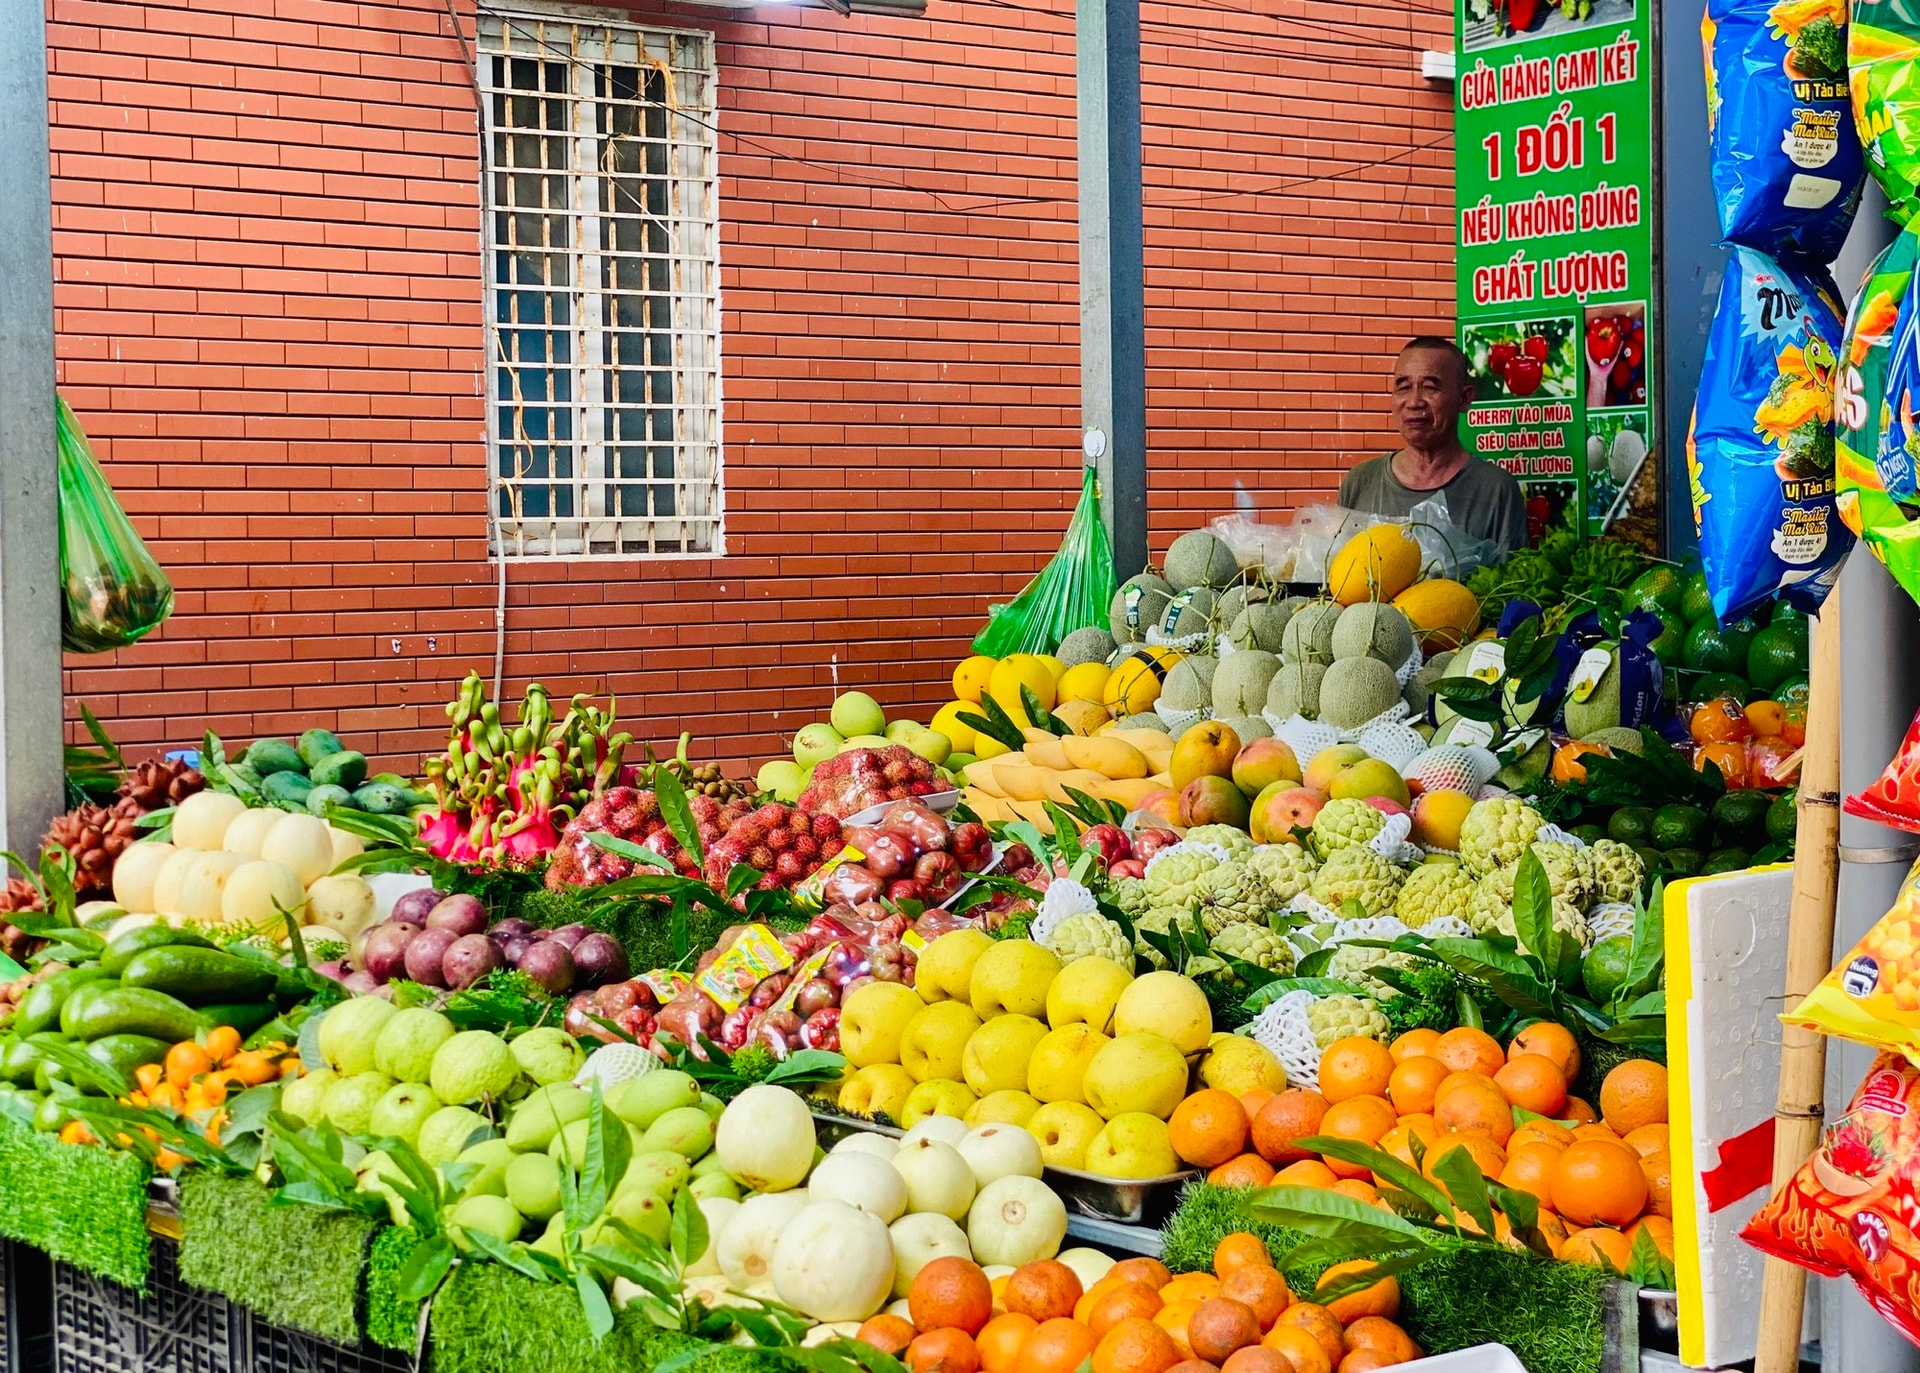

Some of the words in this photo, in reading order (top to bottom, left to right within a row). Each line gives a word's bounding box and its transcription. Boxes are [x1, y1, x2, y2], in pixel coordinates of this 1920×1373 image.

[1462, 59, 1497, 109] CỬA
[1502, 55, 1551, 104] HÀNG
[1556, 49, 1598, 92] CAM
[1602, 30, 1638, 84] KẾT
[1793, 82, 1810, 101] Vị
[1483, 133, 1501, 179] 1
[1516, 101, 1583, 176] ĐỔI
[1596, 113, 1616, 163] 1
[1793, 124, 1816, 139] Mai
[1462, 195, 1502, 246] NẾU
[1506, 192, 1575, 241] KHÔNG
[1580, 182, 1640, 231] ĐÚNG
[1474, 250, 1537, 305] CHẤT
[1543, 251, 1628, 303] LƯỢNG
[1468, 407, 1514, 427] CHERRY
[1516, 403, 1541, 425] VÀO
[1543, 402, 1573, 423] MÙA
[1476, 430, 1505, 452] SIÊU
[1507, 427, 1540, 450] GIẢM
[1542, 427, 1565, 449] GIÁ
[1497, 452, 1528, 475] CHẤT
[1531, 455, 1573, 477] LƯỢNG
[1785, 483, 1800, 501] Vị
[1783, 523, 1807, 536] Mai
